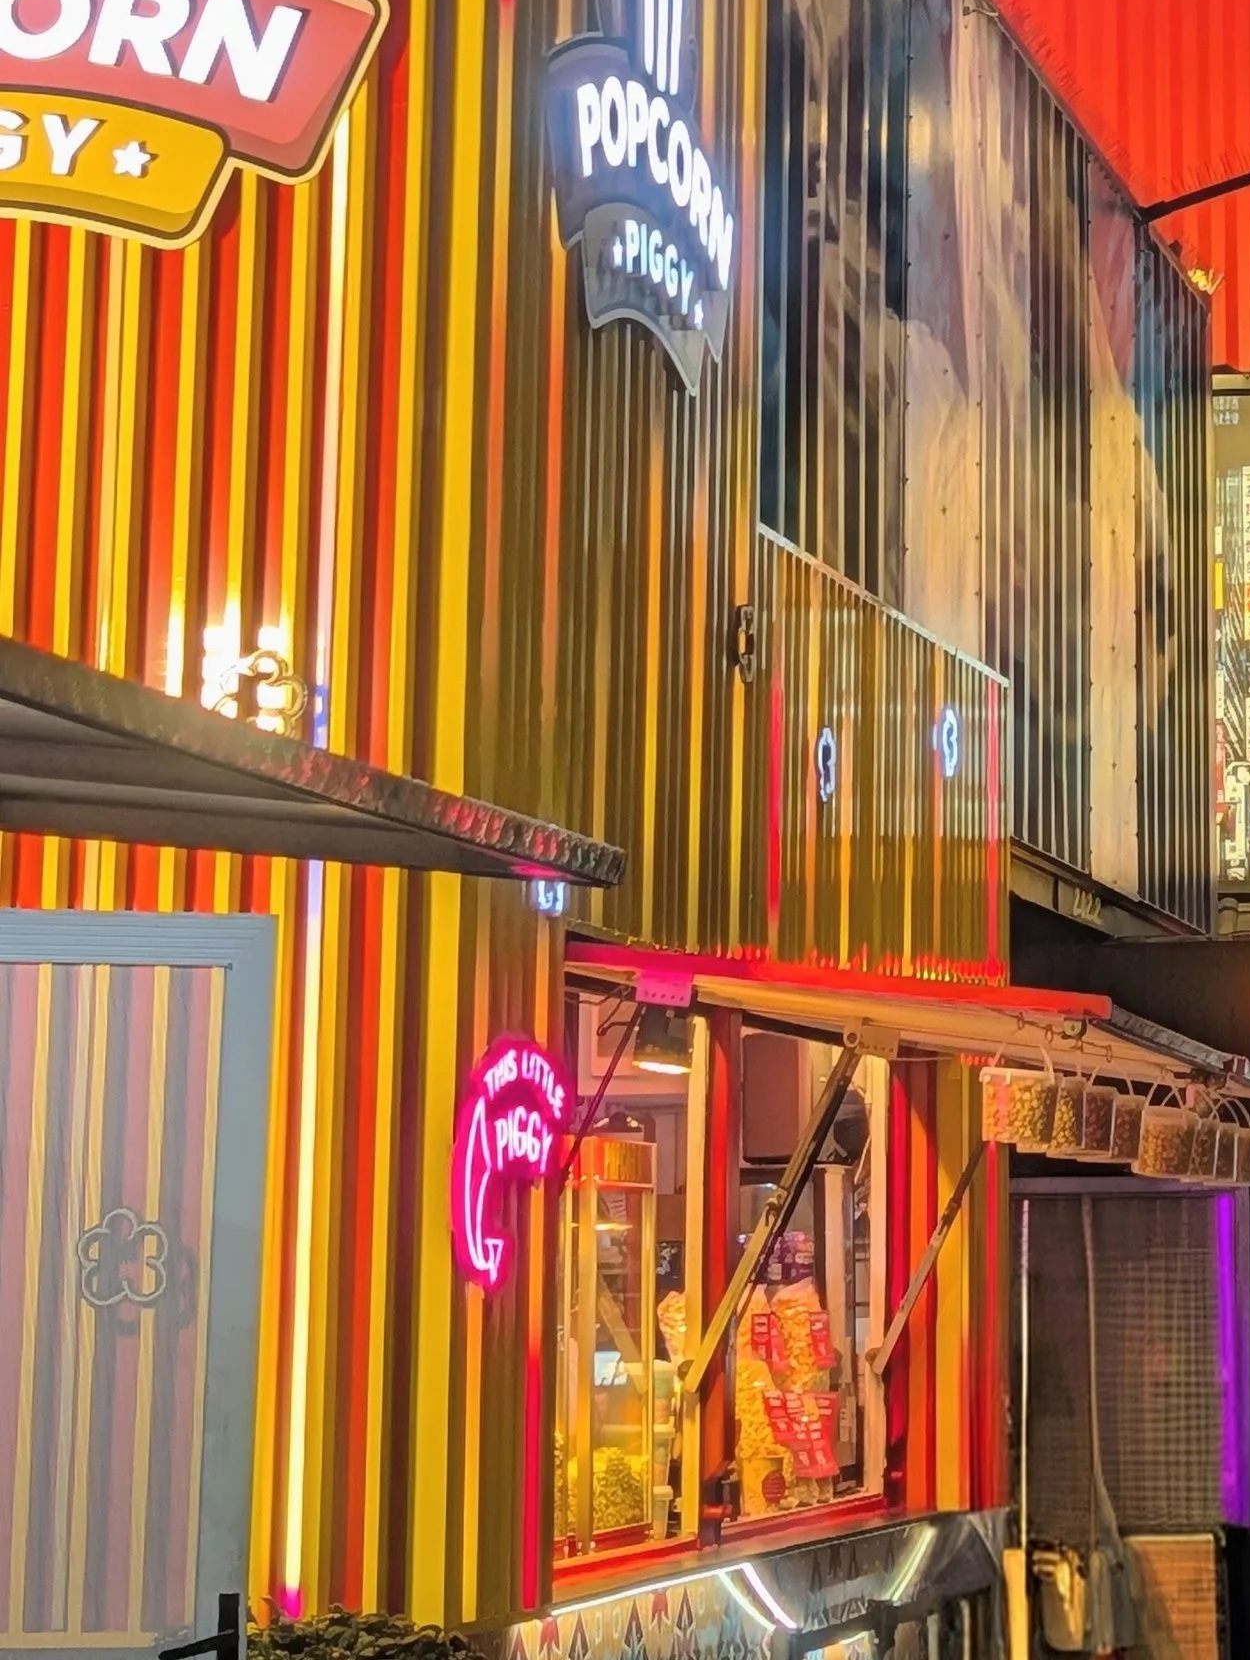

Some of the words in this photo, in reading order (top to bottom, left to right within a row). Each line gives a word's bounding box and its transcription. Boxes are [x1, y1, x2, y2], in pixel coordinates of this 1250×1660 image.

[577, 75, 734, 290] POPCORN
[624, 219, 695, 316] PIGGY
[483, 1048, 518, 1101] THIS
[522, 1049, 566, 1120] LITTLE
[494, 1105, 554, 1174] PIGGY
